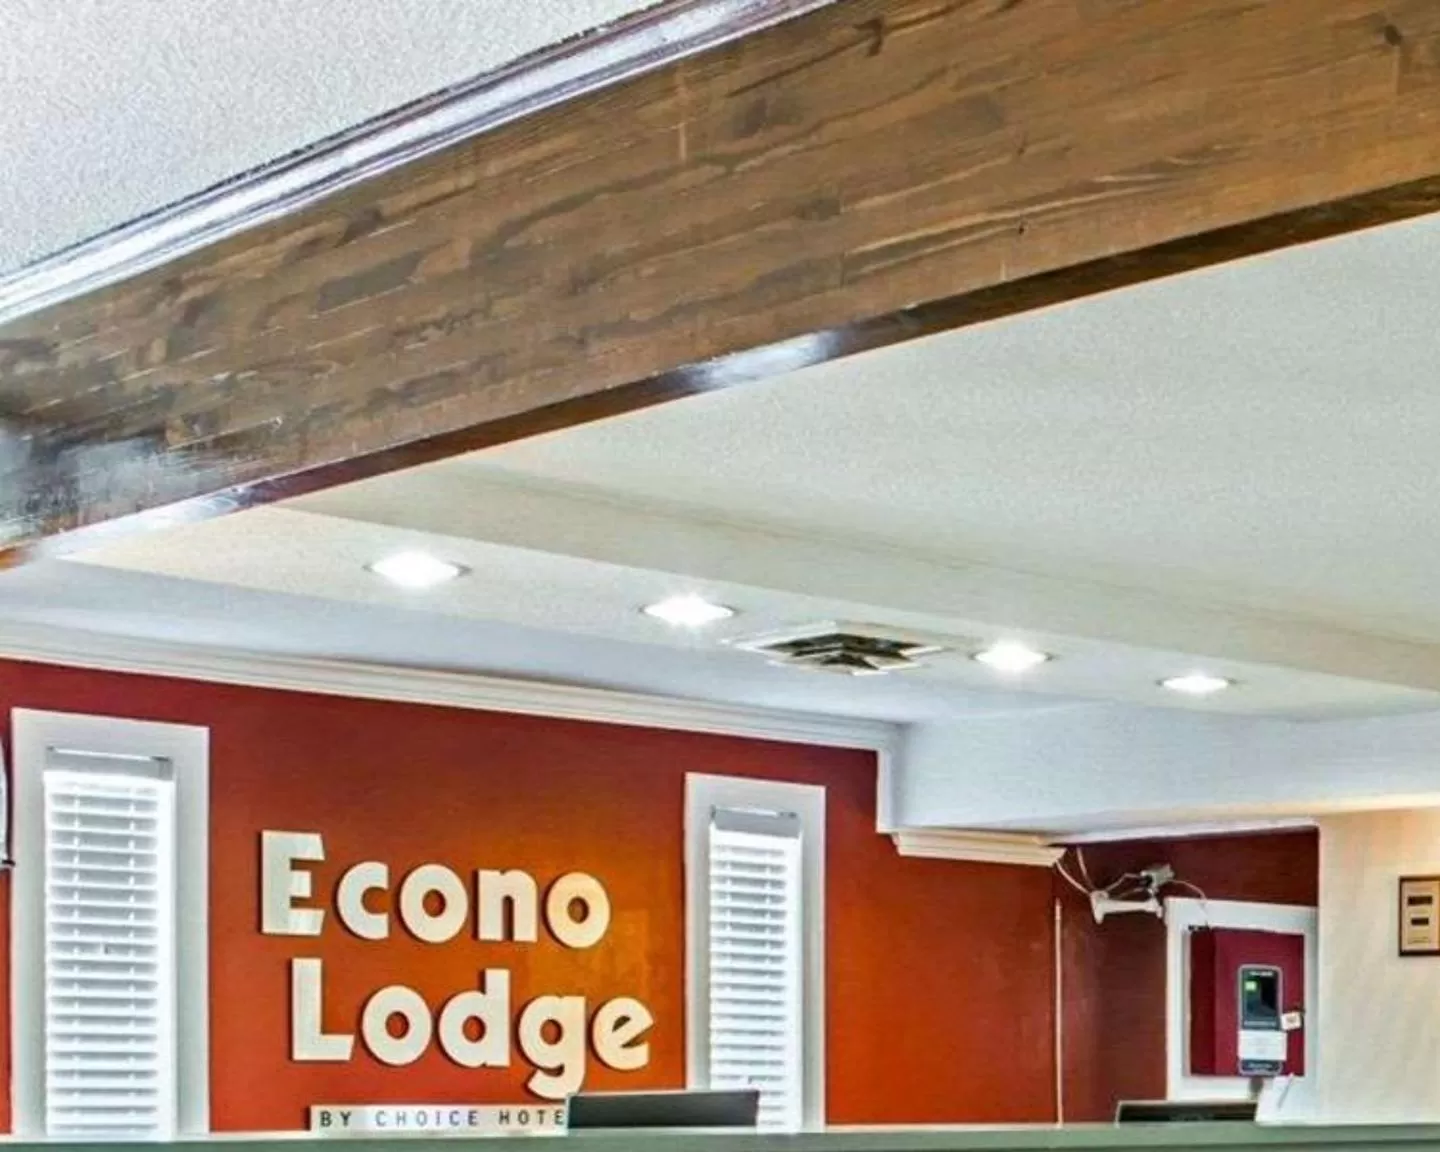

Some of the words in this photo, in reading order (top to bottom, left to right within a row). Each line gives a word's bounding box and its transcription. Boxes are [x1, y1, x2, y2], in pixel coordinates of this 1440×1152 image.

[261, 829, 611, 949] Econo
[292, 958, 655, 1100] Lodge
[319, 1110, 352, 1128] BY
[374, 1110, 479, 1127] CHOICE
[498, 1109, 565, 1127] HOTE
